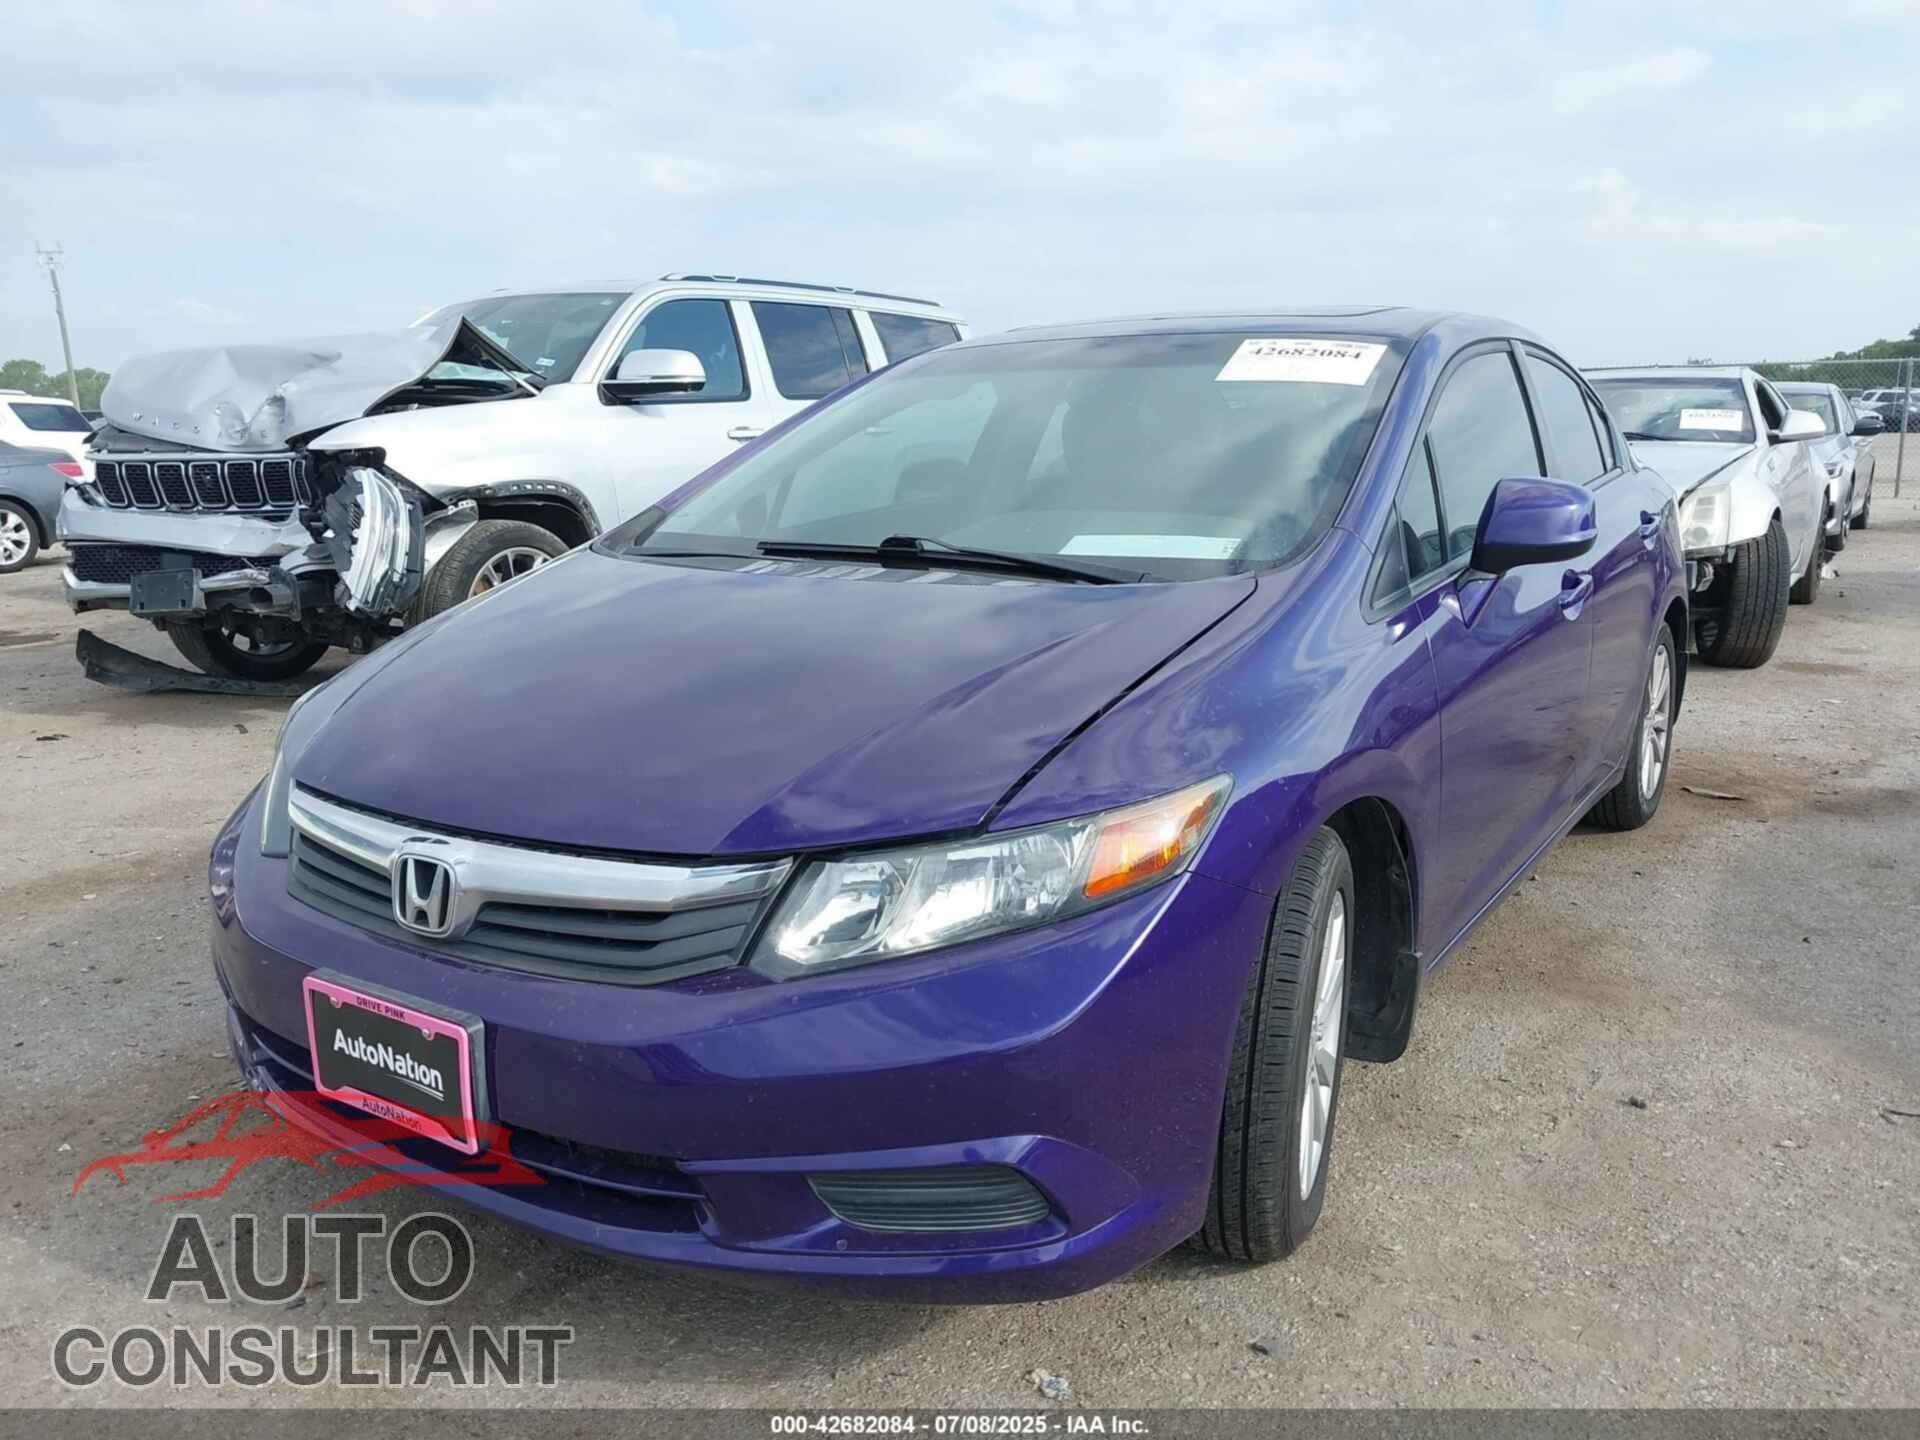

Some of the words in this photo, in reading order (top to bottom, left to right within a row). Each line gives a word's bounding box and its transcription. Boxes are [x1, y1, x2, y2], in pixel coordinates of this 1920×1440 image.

[356, 996, 383, 1013] DRIVE
[384, 1003, 406, 1020] PINK
[333, 1028, 444, 1091] AutoNation
[361, 1097, 423, 1131] AutoNation
